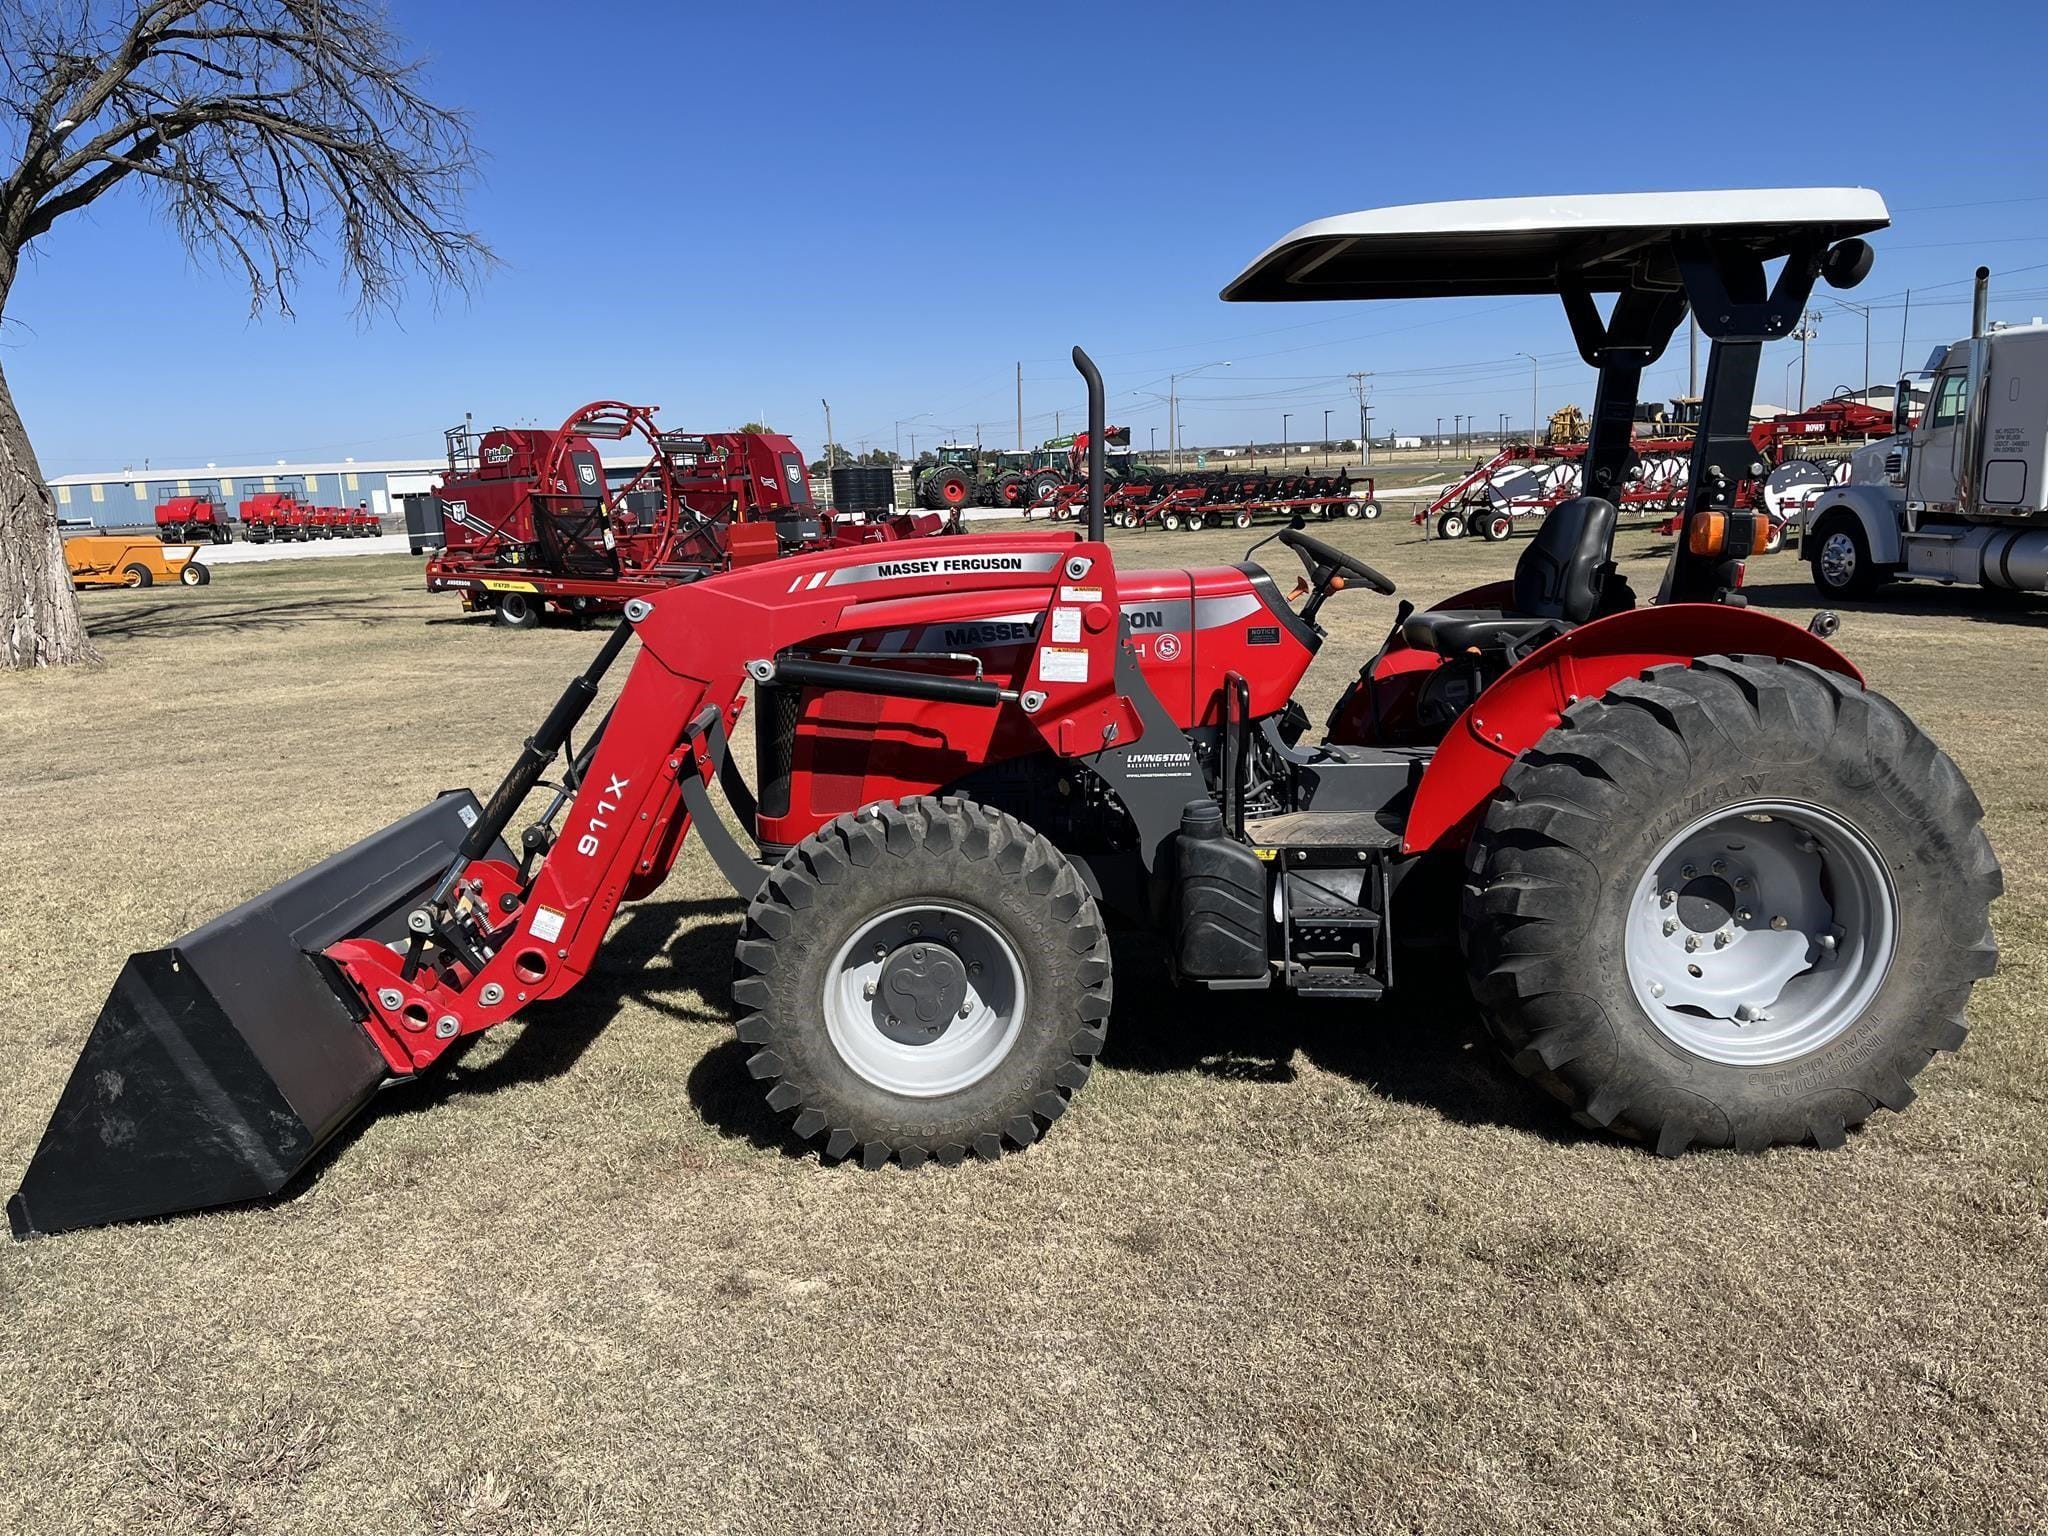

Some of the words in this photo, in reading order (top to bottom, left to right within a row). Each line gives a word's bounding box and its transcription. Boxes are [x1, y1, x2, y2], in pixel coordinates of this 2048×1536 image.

[878, 560, 939, 577] MASSEY
[943, 557, 1022, 571] FERGUSON
[944, 621, 1038, 646] MASSEY
[1127, 753, 1191, 763] LIVINGSTON
[577, 772, 630, 857] 911X
